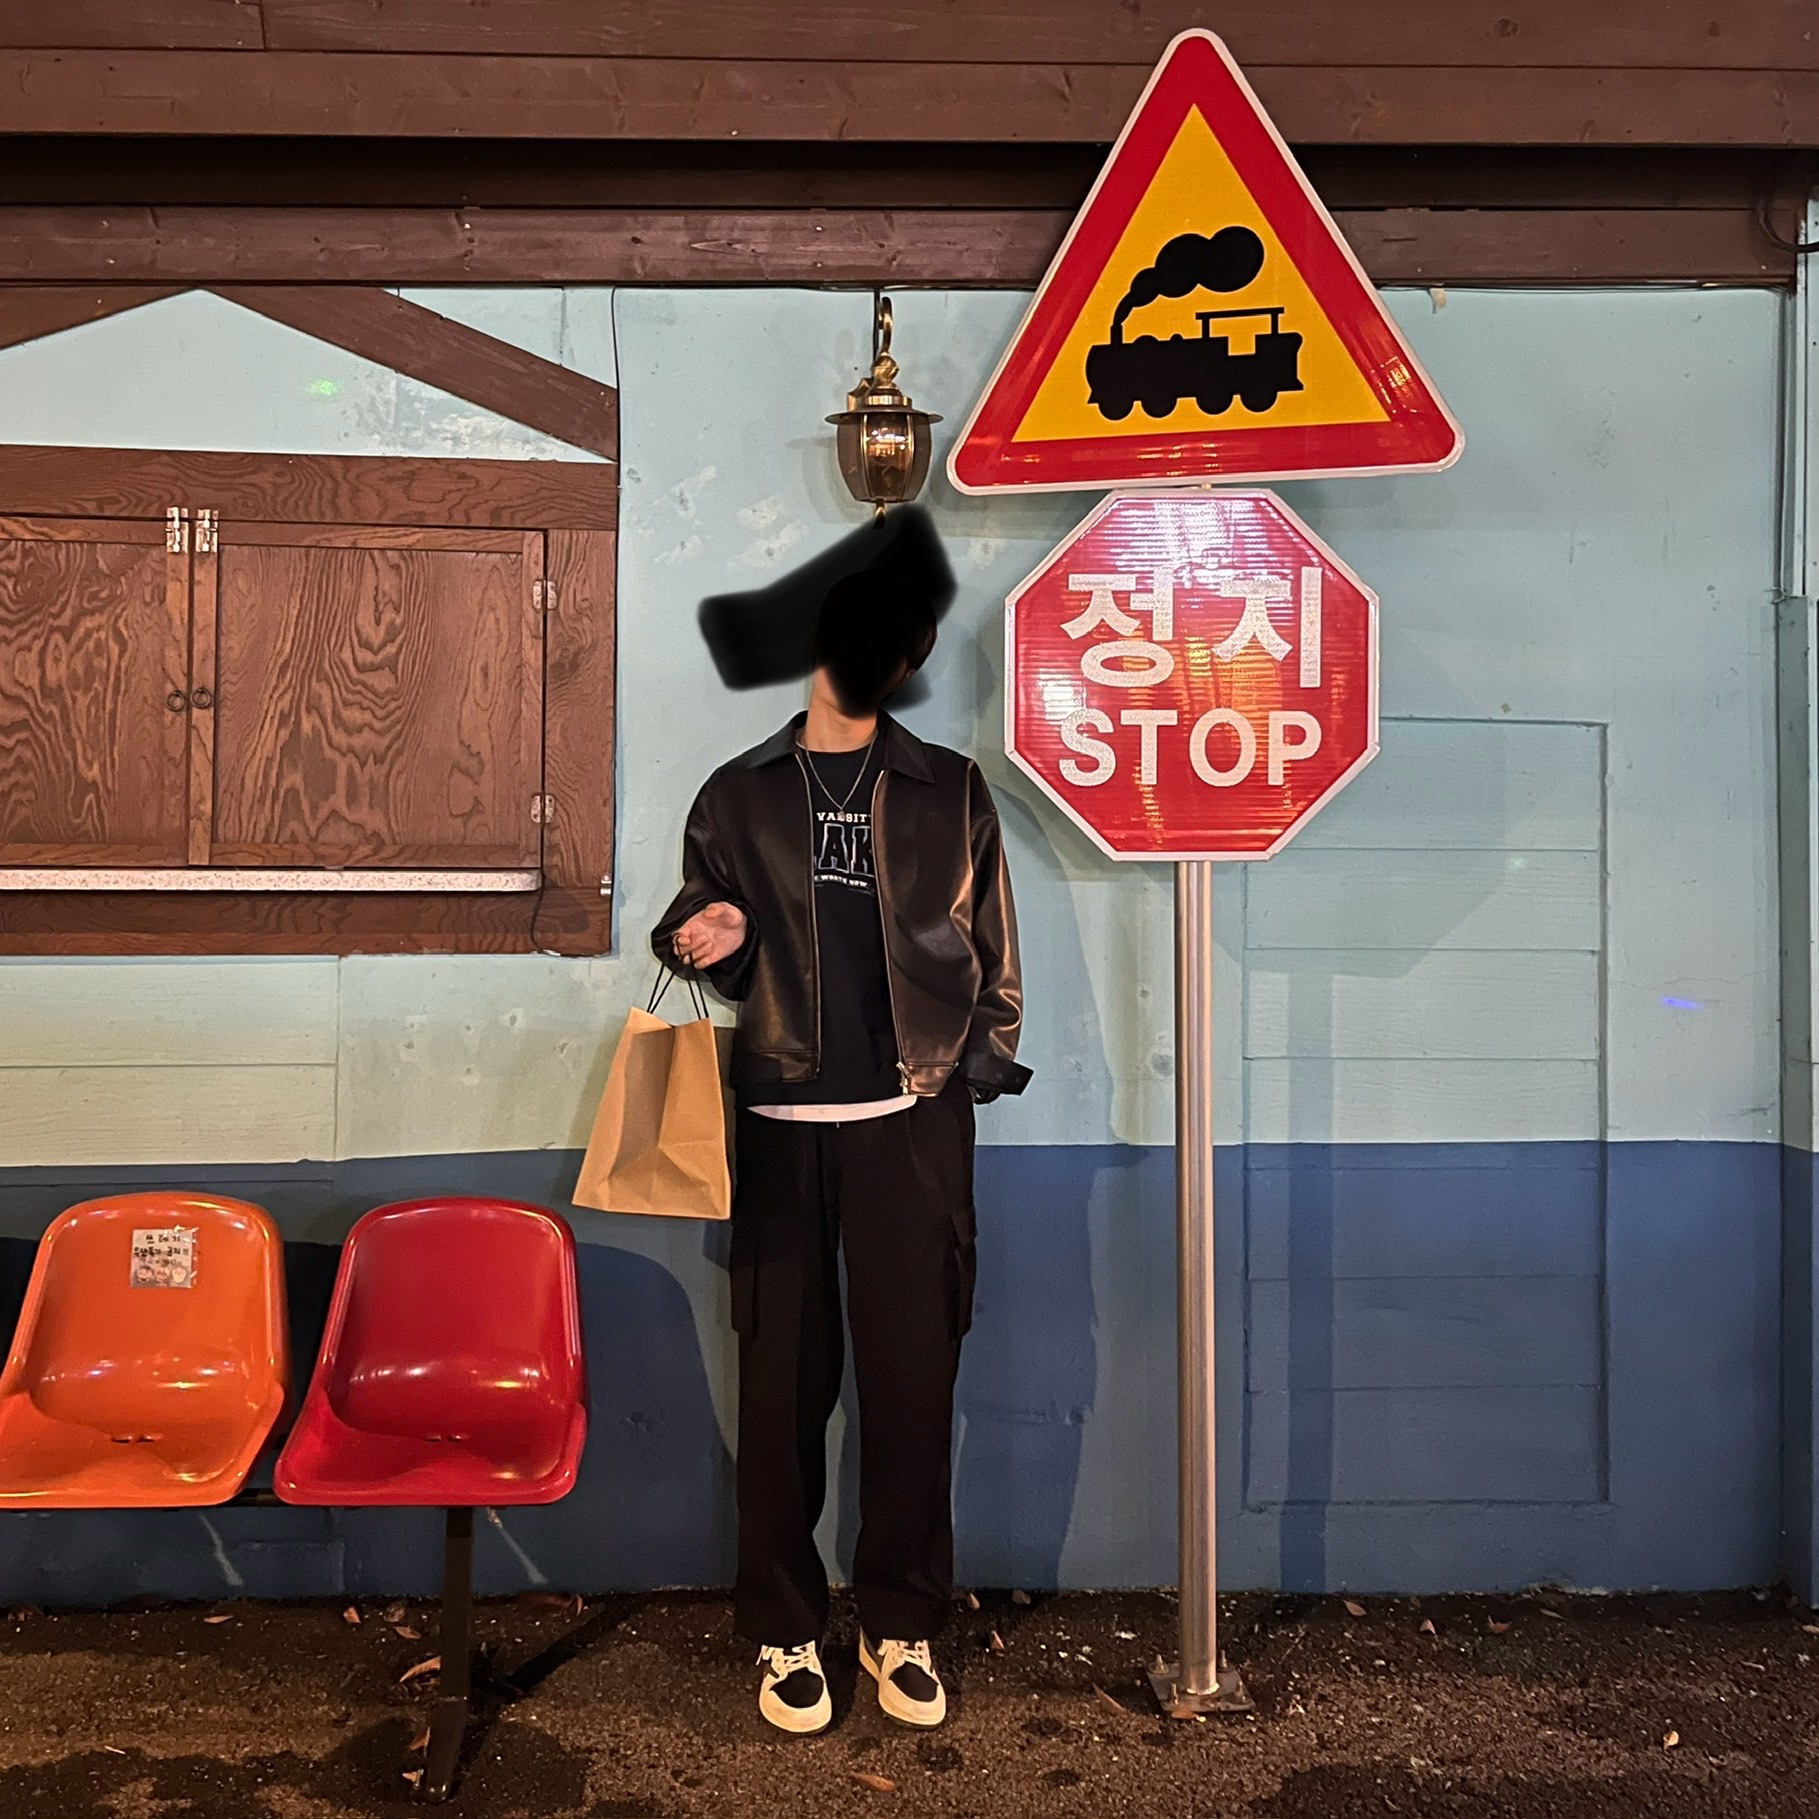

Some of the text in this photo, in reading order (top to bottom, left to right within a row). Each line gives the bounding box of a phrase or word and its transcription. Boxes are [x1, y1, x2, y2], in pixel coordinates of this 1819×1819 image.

[1060, 566, 1322, 688] 정지
[1059, 708, 1322, 788] STOP
[816, 812, 871, 822] VASIT
